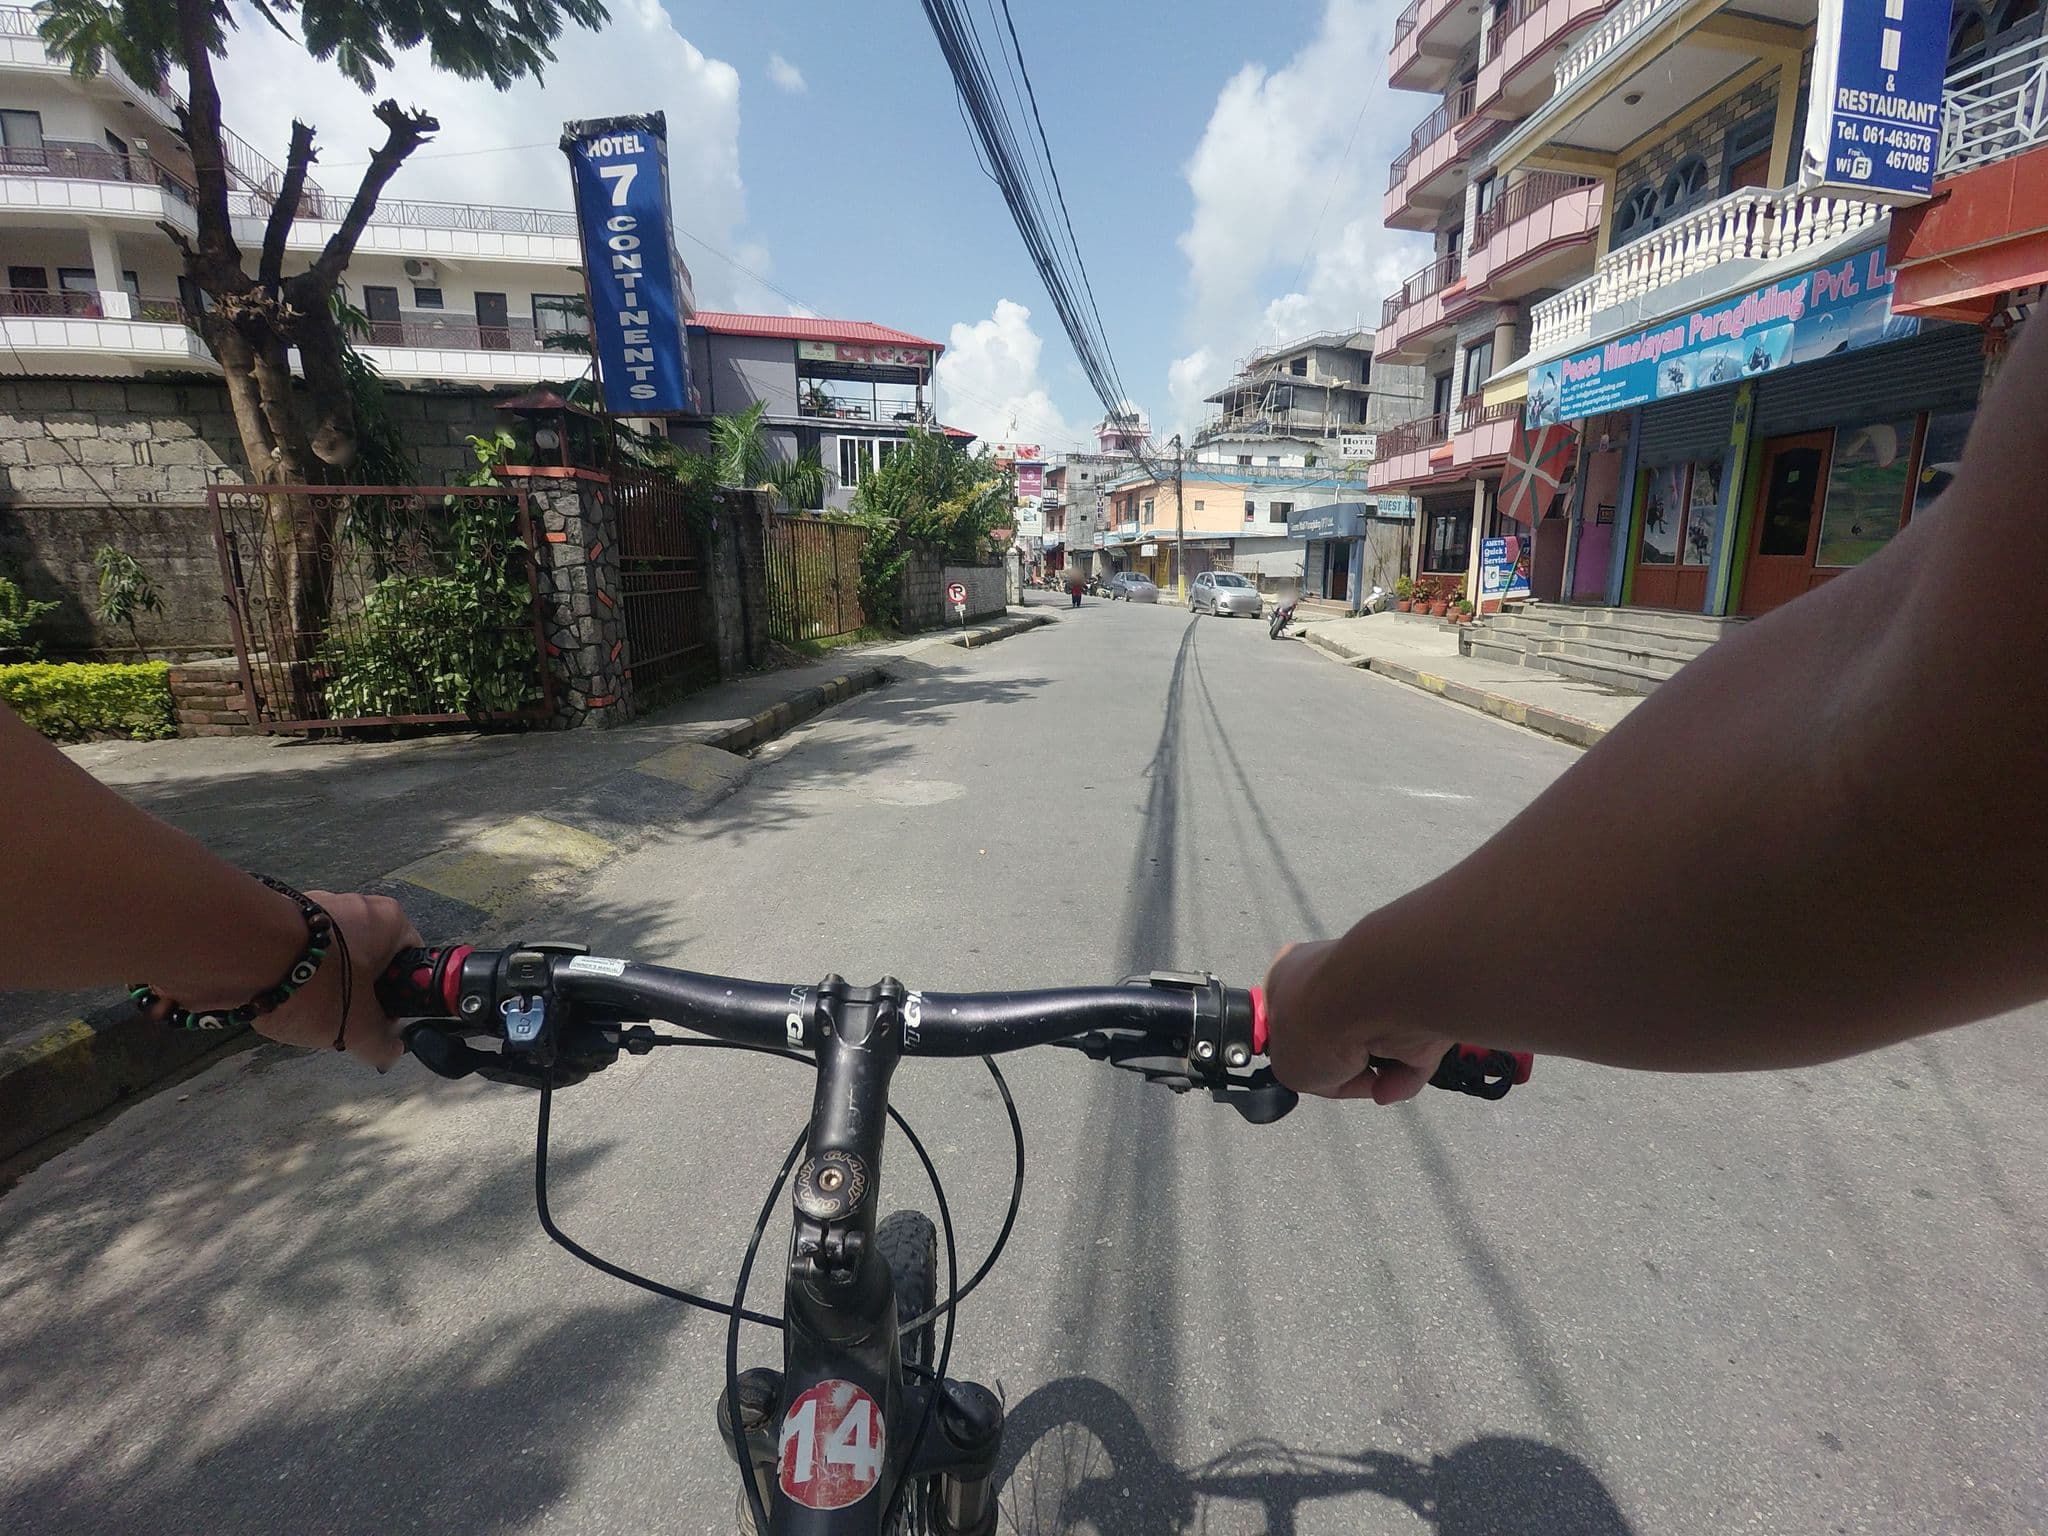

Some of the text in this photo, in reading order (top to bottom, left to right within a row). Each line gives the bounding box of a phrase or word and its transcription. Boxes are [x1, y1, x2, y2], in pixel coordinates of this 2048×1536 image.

[1885, 74, 1895, 92] &
[1838, 88, 1937, 125] RESTAURANT
[587, 135, 645, 158] HOTEL
[1837, 121, 1931, 153] Tel. 061-463678
[1886, 150, 1930, 174] 467085
[600, 163, 638, 206] 7
[607, 215, 657, 400] CONTINENTS
[1562, 354, 1601, 384] Peace
[1603, 324, 1684, 372] Himalayan
[1688, 279, 1808, 346] Paragliding
[1811, 261, 1860, 308] Pvt.
[1343, 437, 1373, 445] HOTEL
[1343, 446, 1373, 455] EZEN
[1379, 499, 1402, 512] GUEST
[1484, 548, 1503, 557] Quick
[780, 1399, 878, 1484] 14
